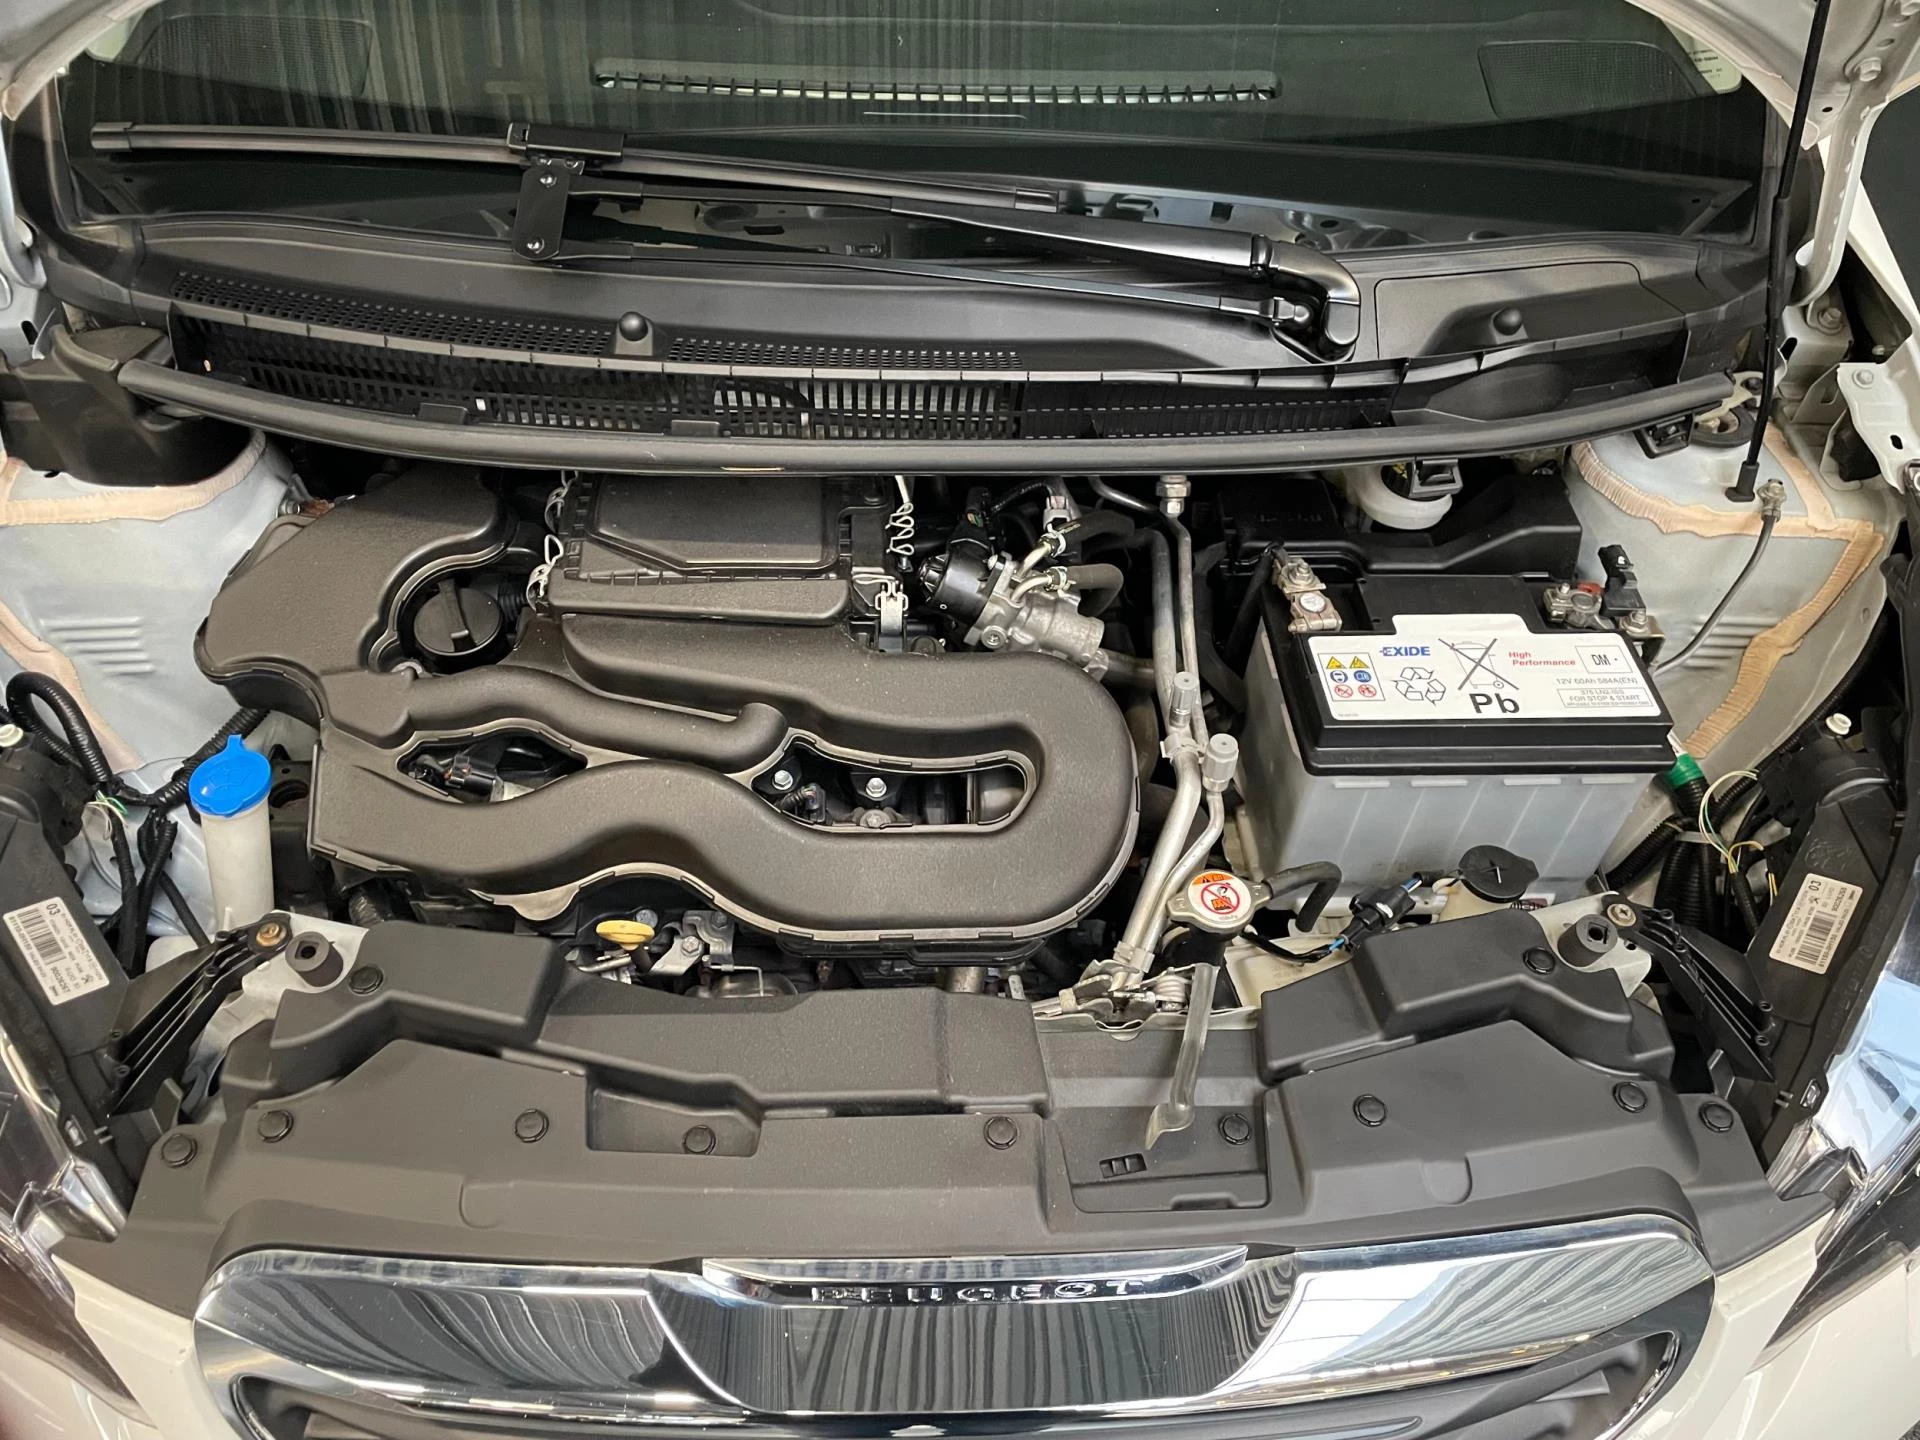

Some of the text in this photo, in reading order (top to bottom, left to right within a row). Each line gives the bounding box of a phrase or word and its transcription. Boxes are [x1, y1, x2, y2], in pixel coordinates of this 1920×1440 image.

[1380, 646, 1431, 657] EXIDE
[1508, 651, 1532, 660] High
[1512, 658, 1576, 667] Performance
[1469, 692, 1520, 714] Pb
[1615, 694, 1641, 702] START
[1808, 880, 1822, 892] 03
[46, 903, 61, 916] 03
[810, 1280, 1145, 1303] PEUGEOT
